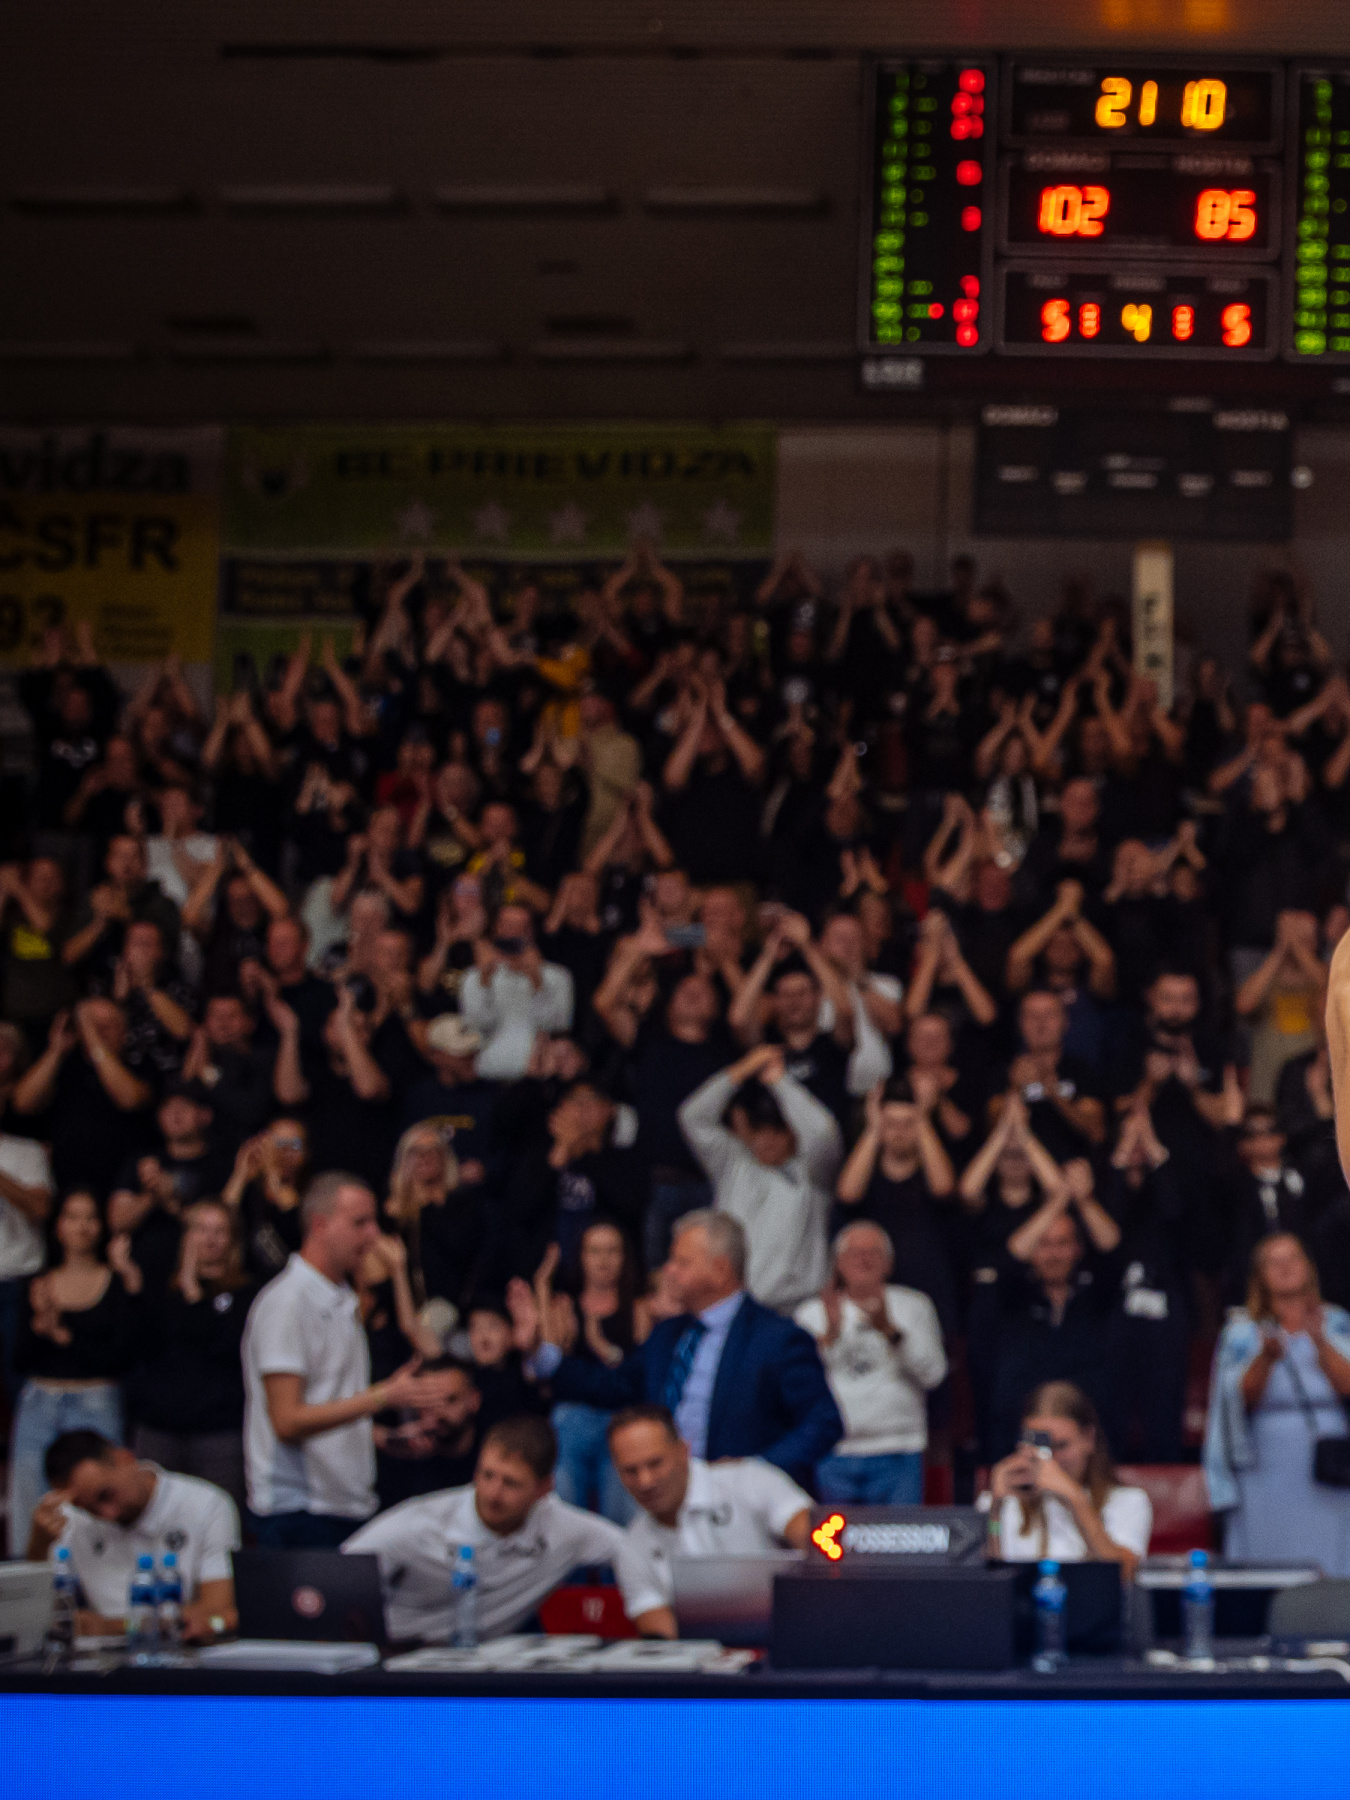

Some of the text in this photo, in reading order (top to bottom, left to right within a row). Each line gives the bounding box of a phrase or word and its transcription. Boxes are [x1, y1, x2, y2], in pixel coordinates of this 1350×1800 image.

[1038, 186, 1110, 237] 102
[1196, 189, 1257, 241] 85
[842, 1523, 950, 1554] POSSESSION
